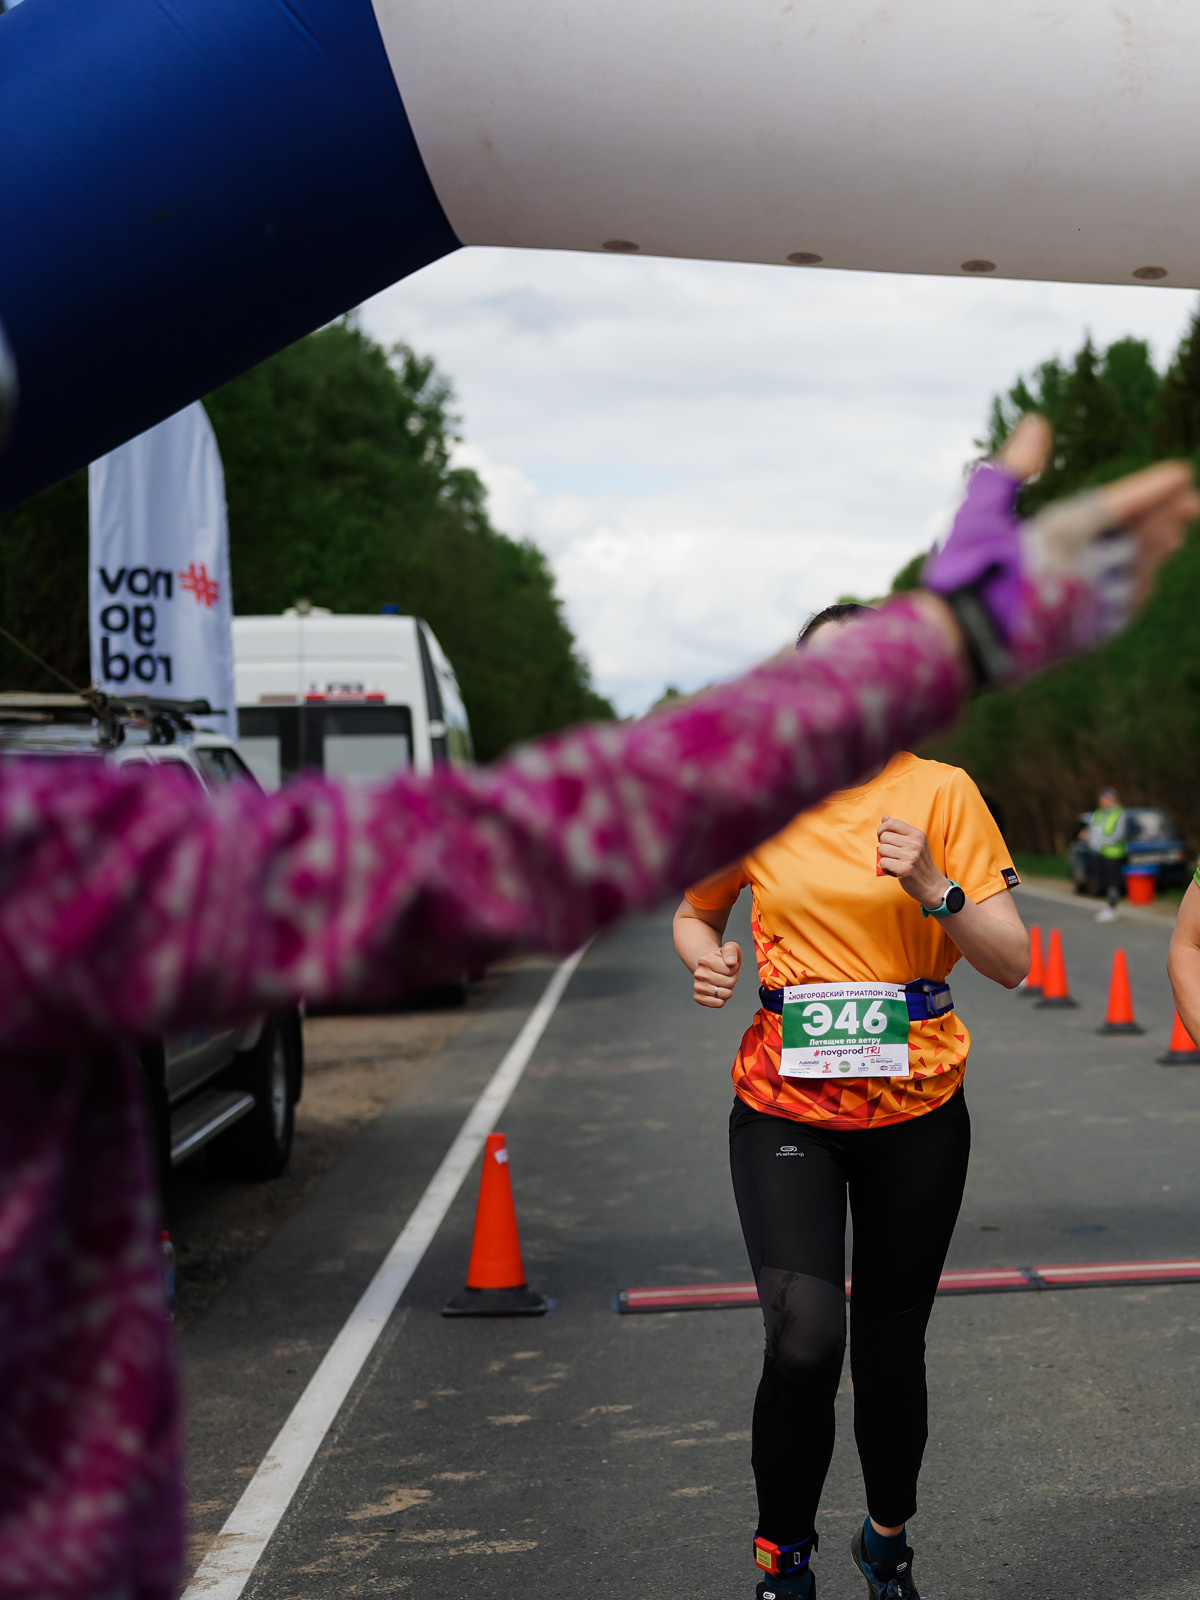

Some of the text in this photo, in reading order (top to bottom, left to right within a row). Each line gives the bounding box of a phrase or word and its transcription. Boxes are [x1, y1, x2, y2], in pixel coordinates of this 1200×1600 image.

[791, 990, 845, 1000] НОВГОРОДСКИЙ
[802, 1000, 888, 1036] Э46
[809, 1038, 845, 1046] Летящие
[858, 1038, 881, 1046] ветру
